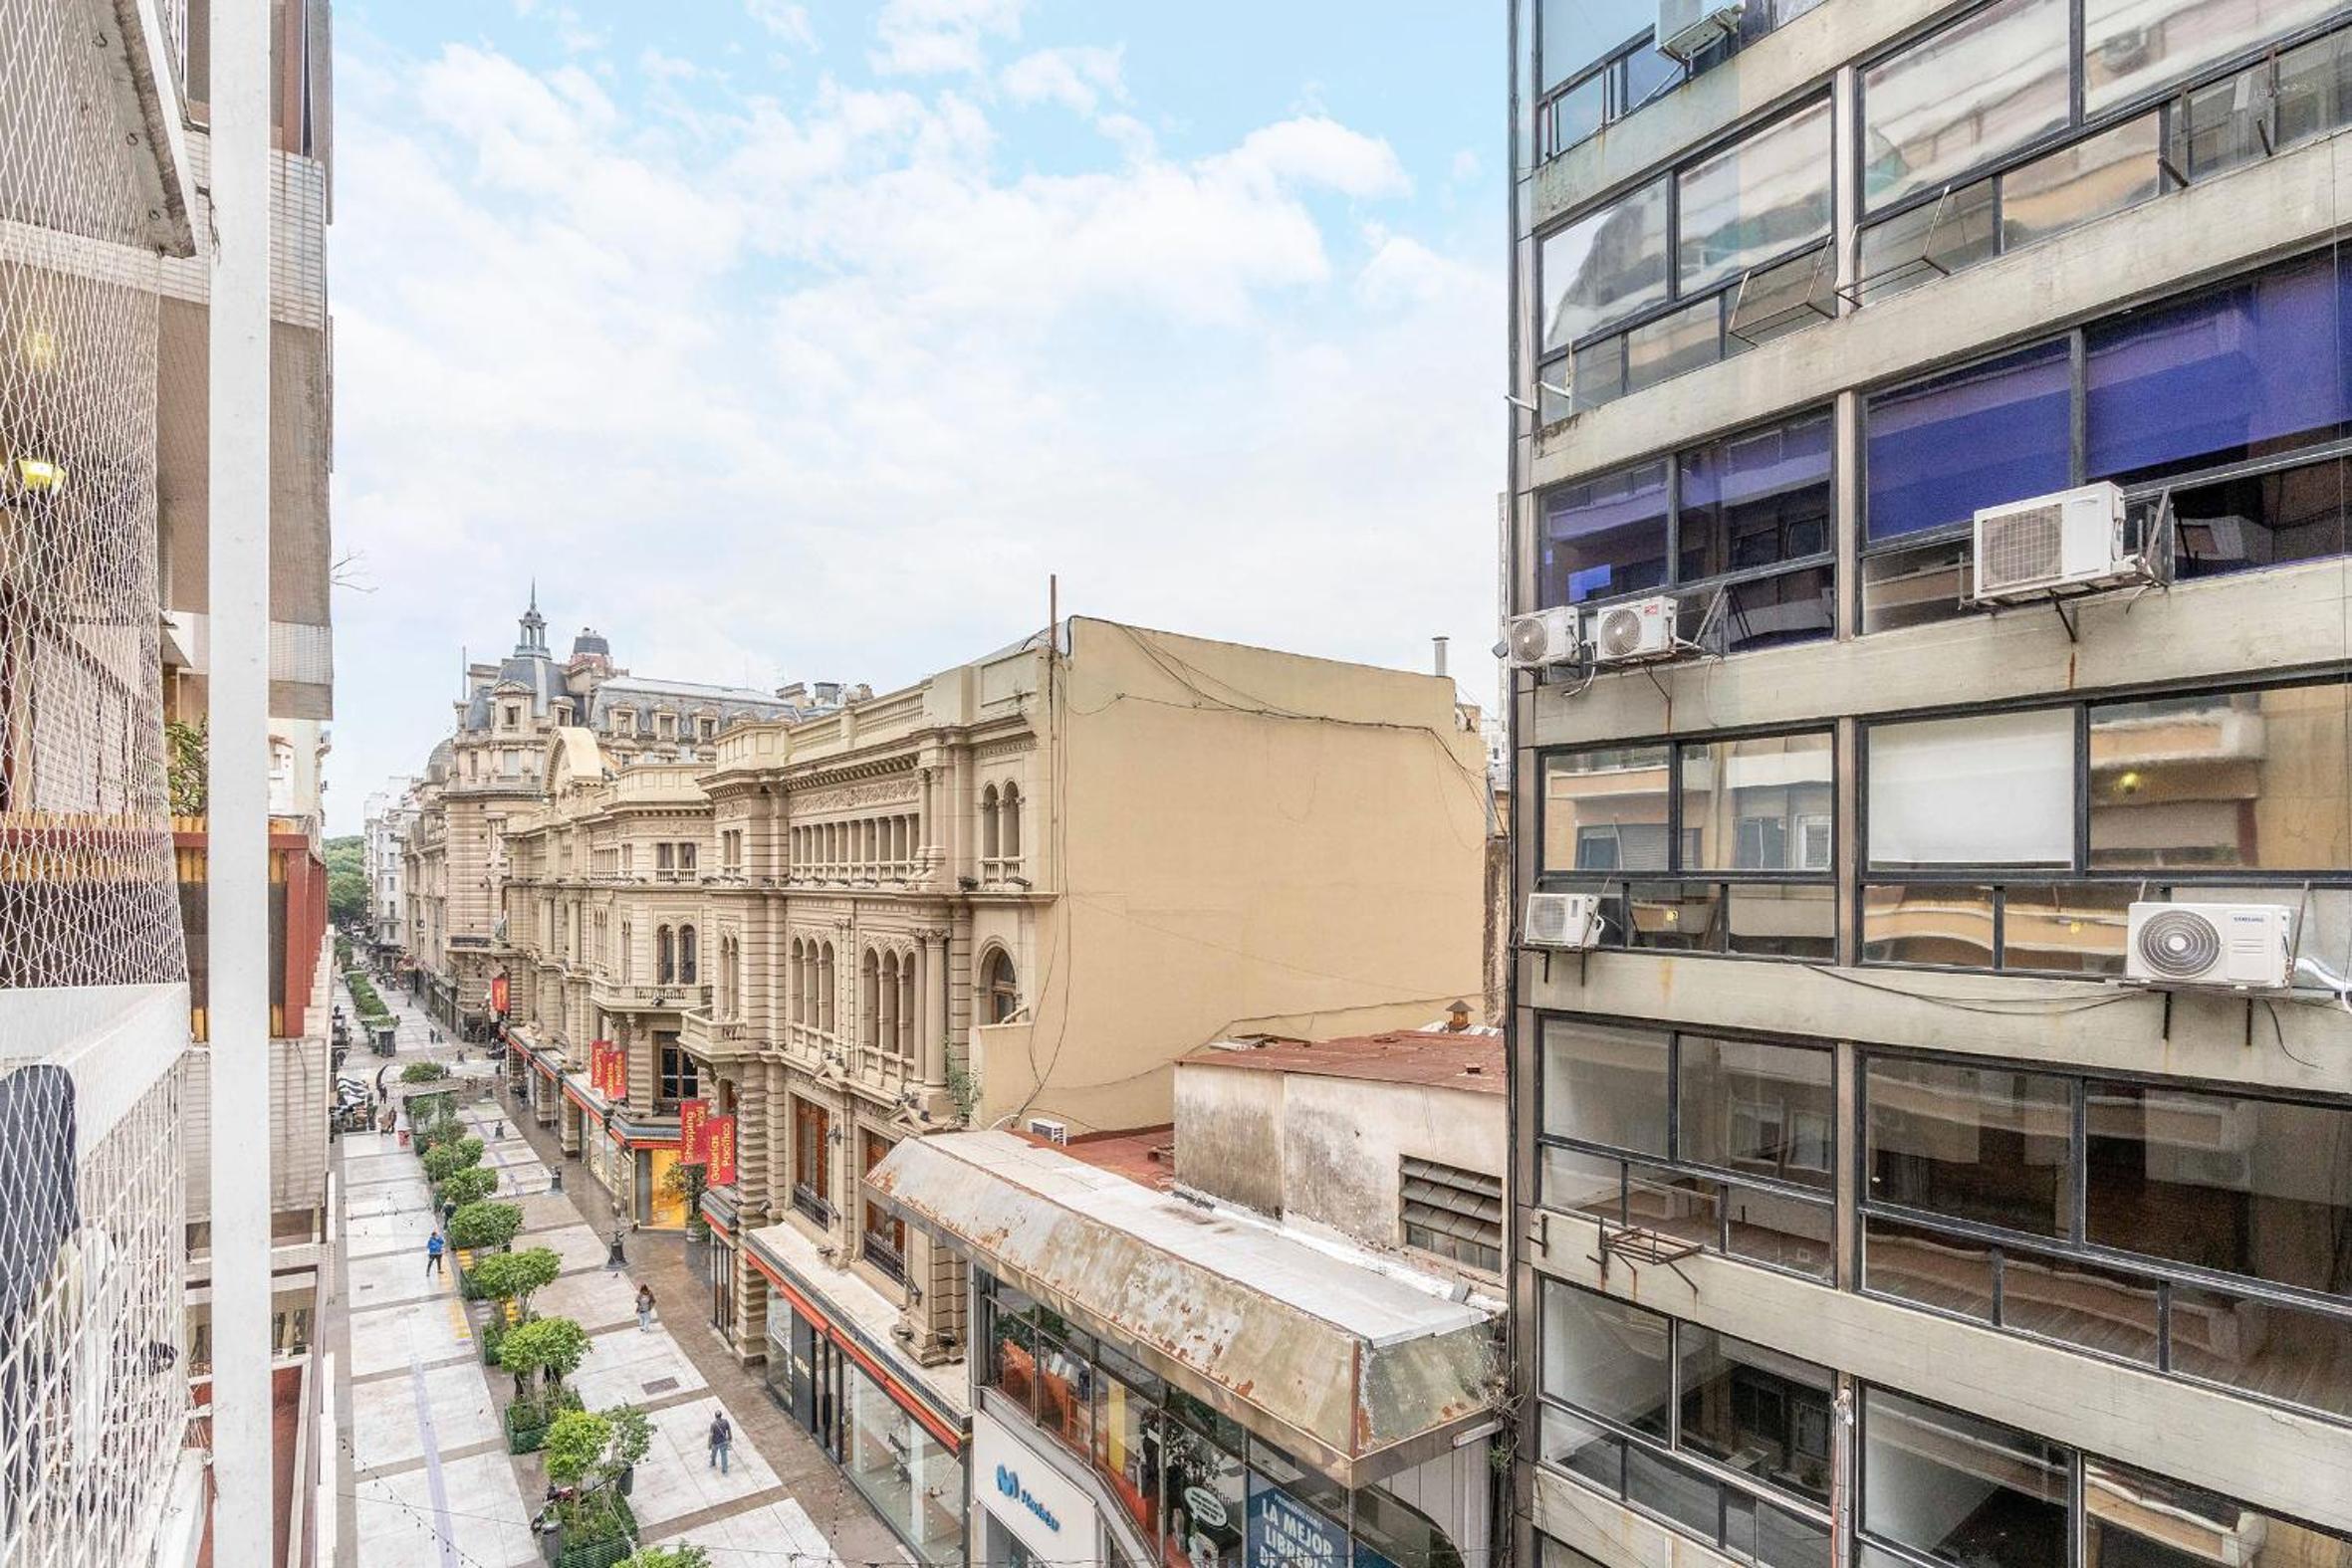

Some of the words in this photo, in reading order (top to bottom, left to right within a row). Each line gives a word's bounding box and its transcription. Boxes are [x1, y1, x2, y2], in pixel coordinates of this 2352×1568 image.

[685, 1111, 696, 1162] Shopping
[1262, 1497, 1280, 1526] LA
[1284, 1512, 1334, 1565] MEJOR
